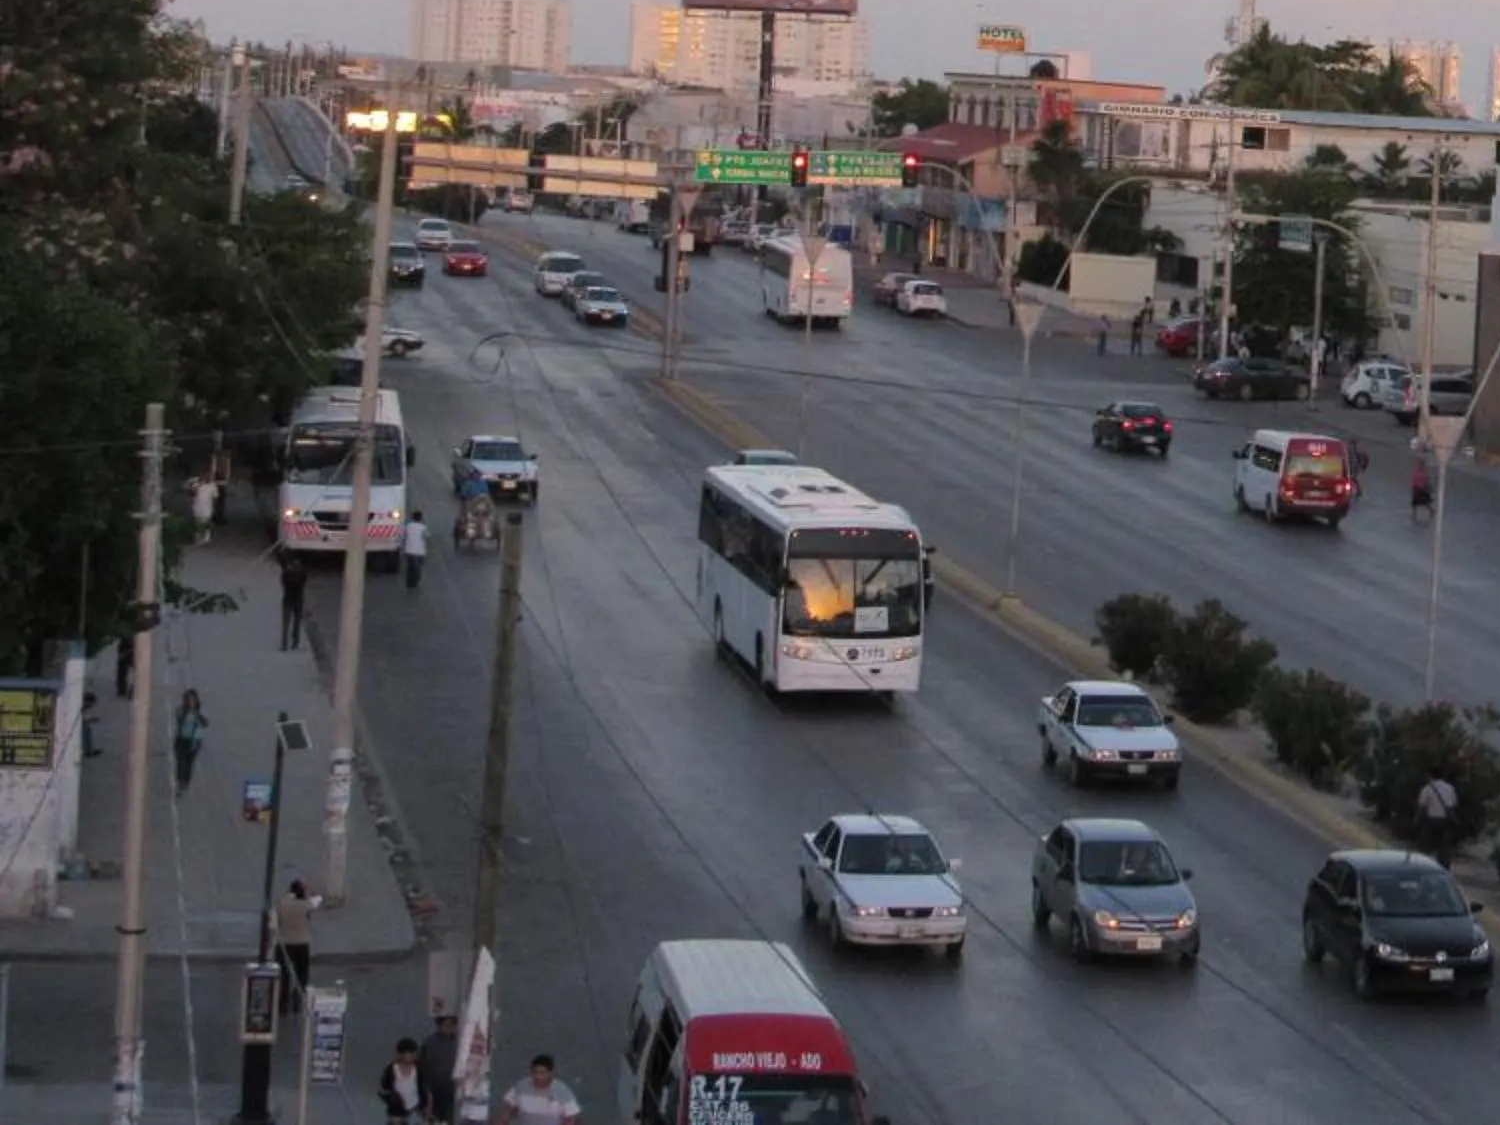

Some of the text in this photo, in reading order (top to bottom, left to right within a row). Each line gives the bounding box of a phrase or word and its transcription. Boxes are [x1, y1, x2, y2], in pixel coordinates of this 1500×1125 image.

[979, 26, 1024, 39] HOTEL
[713, 1052, 754, 1070] RANCHO
[756, 1052, 786, 1069] VIEJO
